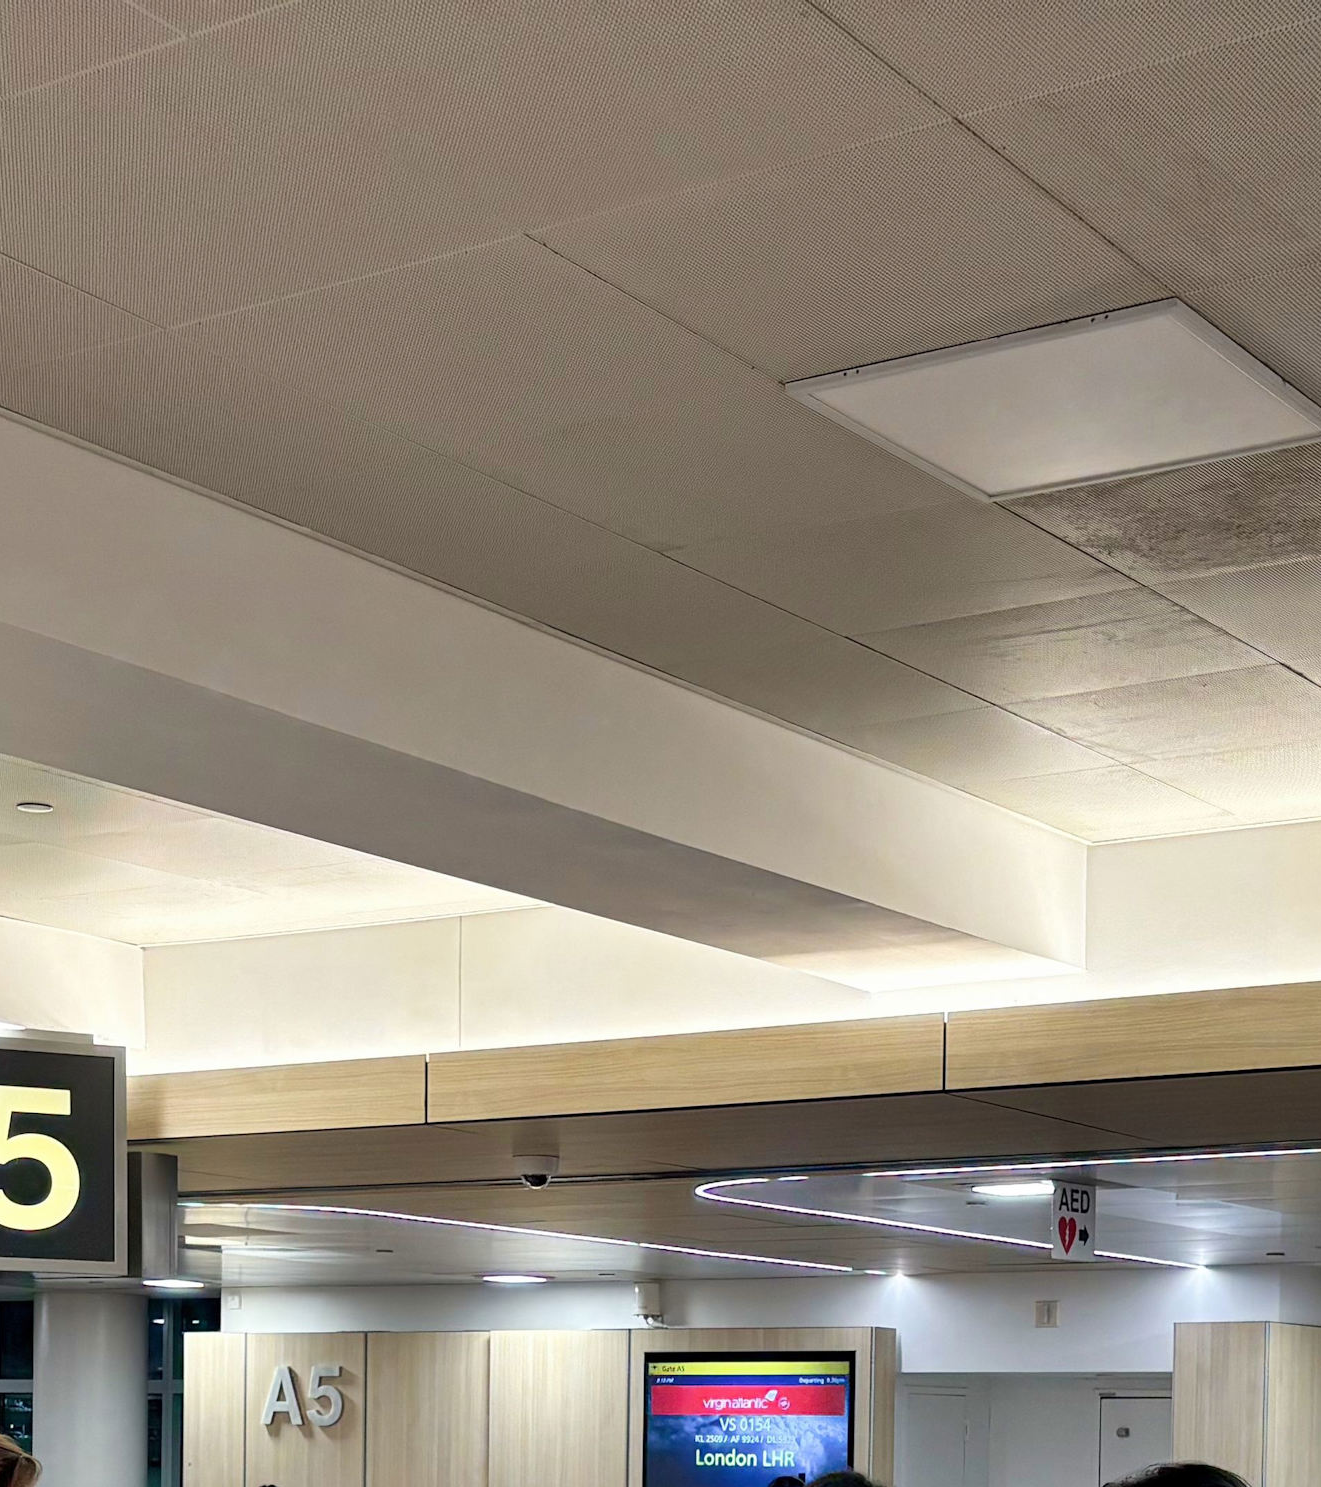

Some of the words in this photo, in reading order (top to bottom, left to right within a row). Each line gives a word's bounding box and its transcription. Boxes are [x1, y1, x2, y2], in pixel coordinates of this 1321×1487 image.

[1059, 1187, 1090, 1214] AED
[260, 1365, 344, 1427] A5
[719, 1417, 736, 1431] VS
[739, 1417, 772, 1432] 0154
[695, 1448, 758, 1467] London
[762, 1450, 796, 1467] LHR
